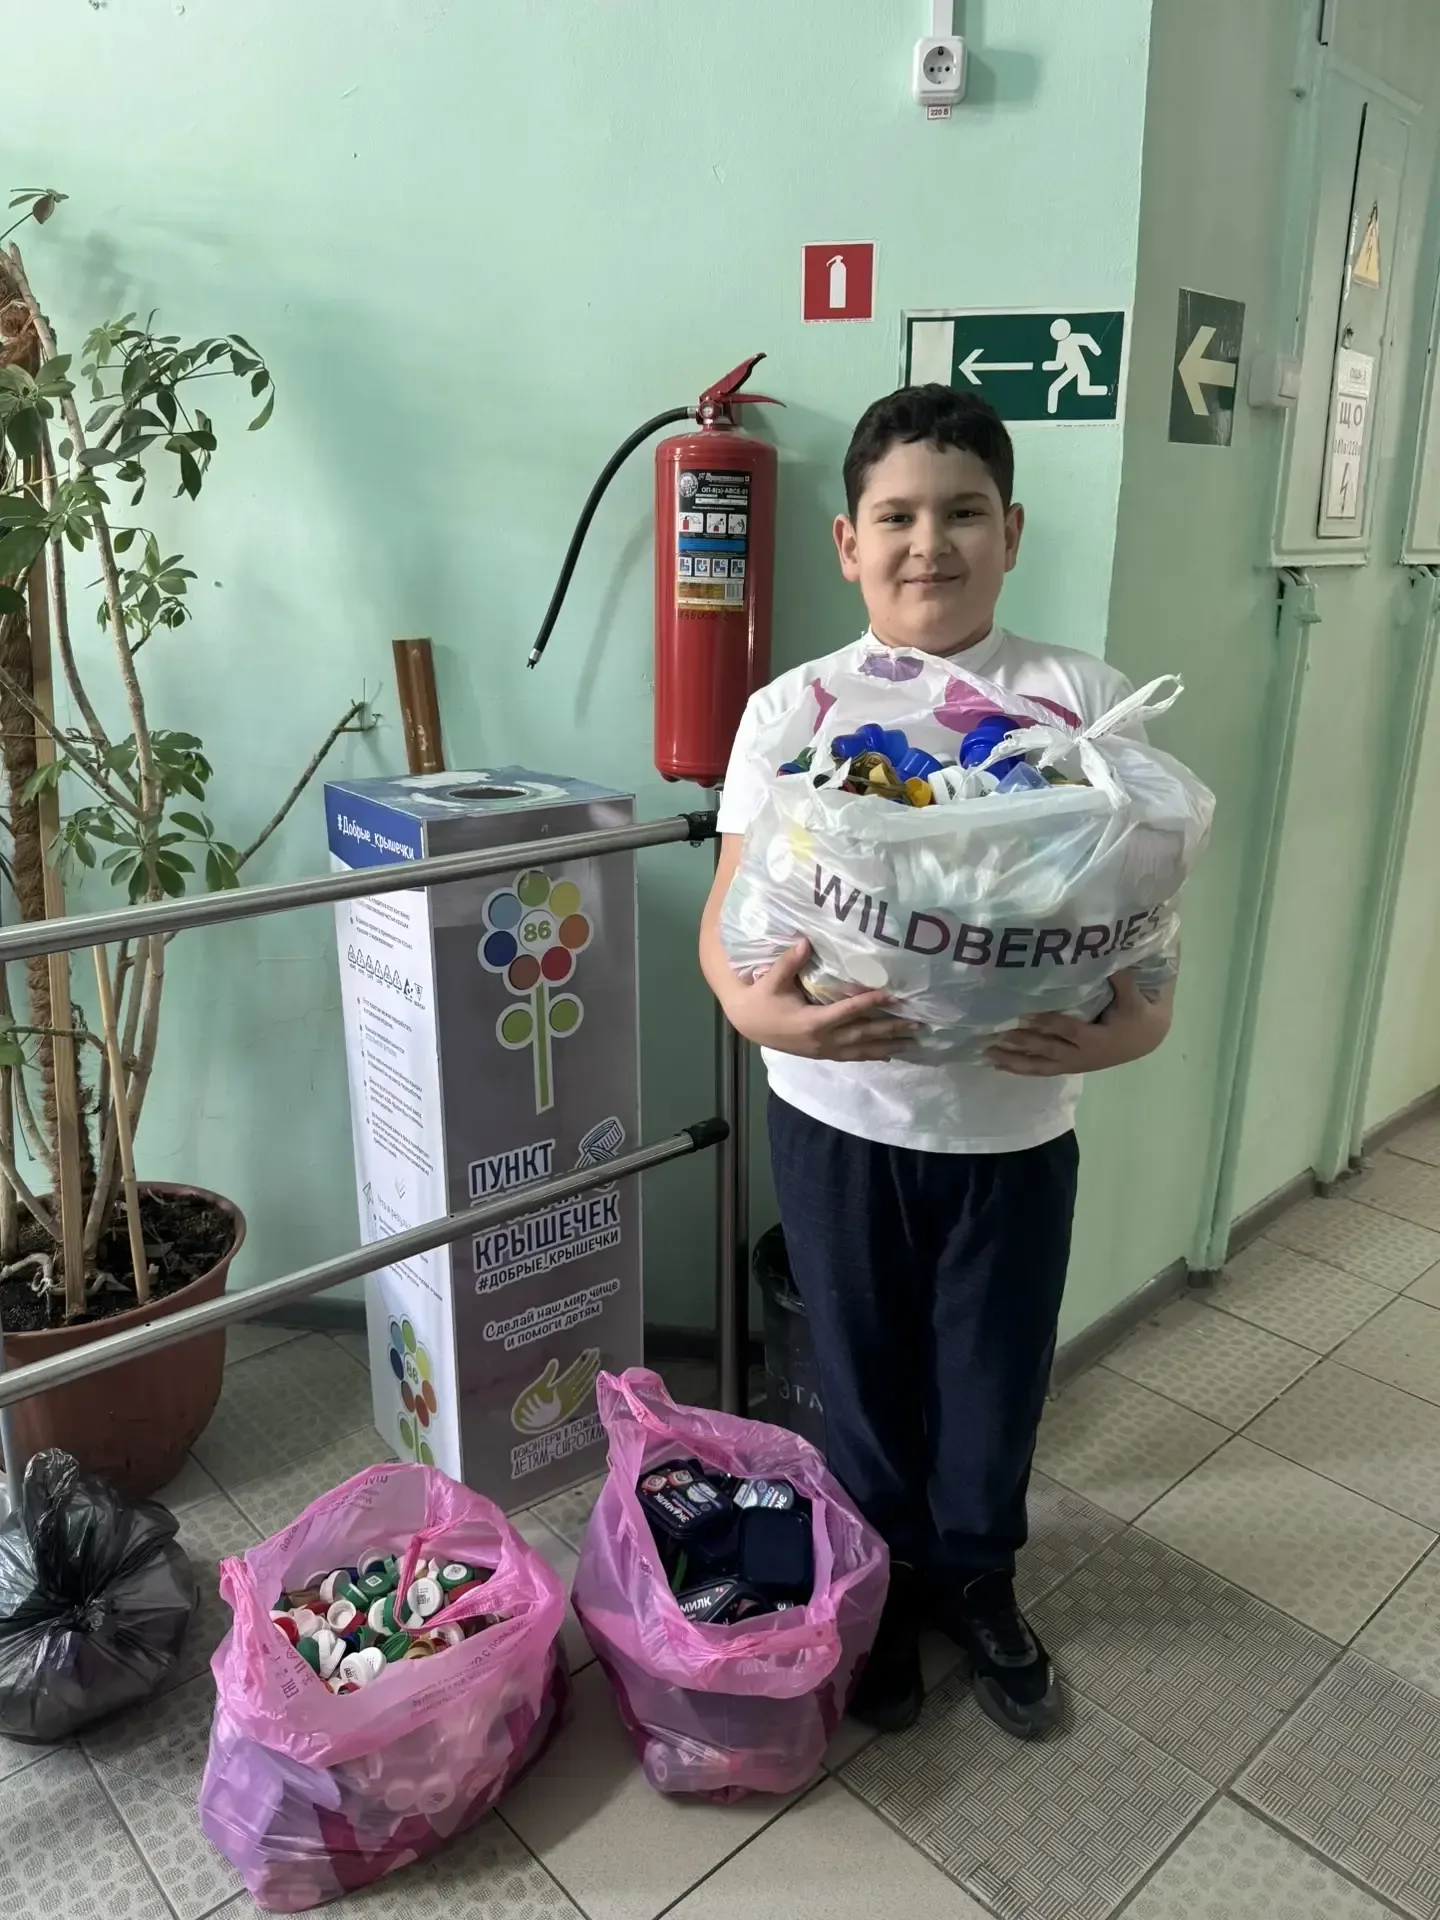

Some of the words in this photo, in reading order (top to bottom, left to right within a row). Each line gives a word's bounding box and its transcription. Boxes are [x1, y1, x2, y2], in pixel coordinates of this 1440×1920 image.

[930, 108, 943, 116] 220
[337, 813, 415, 861] #Добрые_крышечки
[523, 920, 552, 943] 86
[471, 1143, 553, 1196] ПУНКТ
[475, 1193, 618, 1271] КРЫШЕЧЕК
[478, 1230, 619, 1292] #ДОБРЫЕ_КРЫШЕЧКИ
[485, 1312, 535, 1339] Сделай
[537, 1303, 561, 1320] наш
[563, 1292, 588, 1310] мир
[589, 1280, 618, 1299] чище
[506, 1337, 516, 1349] и
[518, 1319, 562, 1343] помоги
[565, 1304, 601, 1327] детям
[406, 1359, 419, 1385] 86
